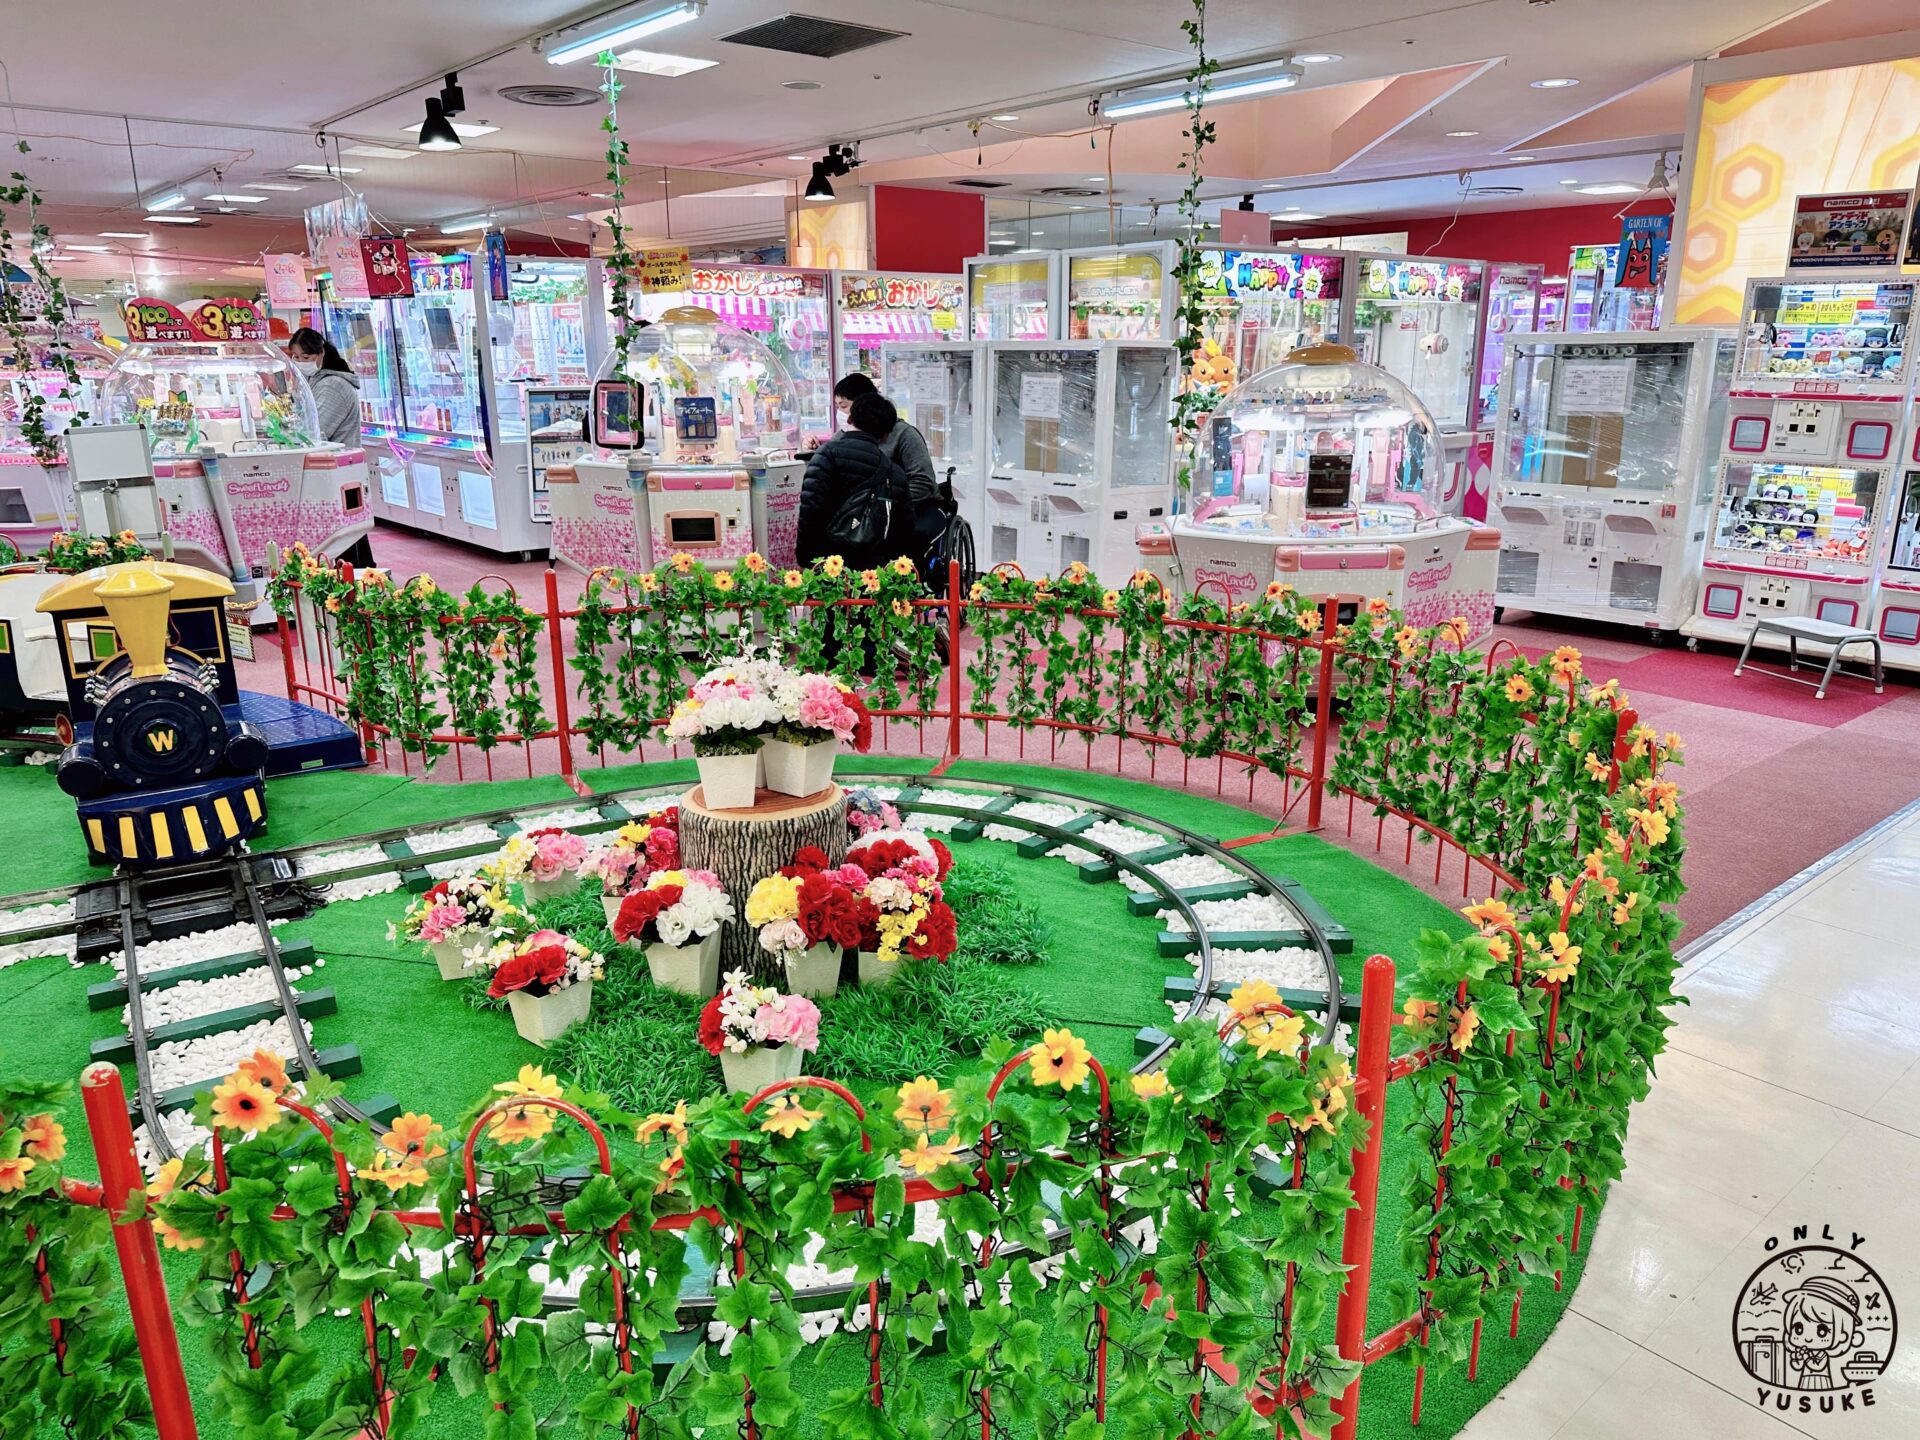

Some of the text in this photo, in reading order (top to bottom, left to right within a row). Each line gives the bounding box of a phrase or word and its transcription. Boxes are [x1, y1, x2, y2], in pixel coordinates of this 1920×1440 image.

[1628, 217, 1663, 228] GARTEN OF
[693, 270, 756, 292] おかし
[1499, 276, 1528, 285] namco
[886, 279, 940, 307] おかし
[1209, 559, 1237, 567] namco
[1424, 555, 1443, 564] namco
[147, 729, 174, 752] W
